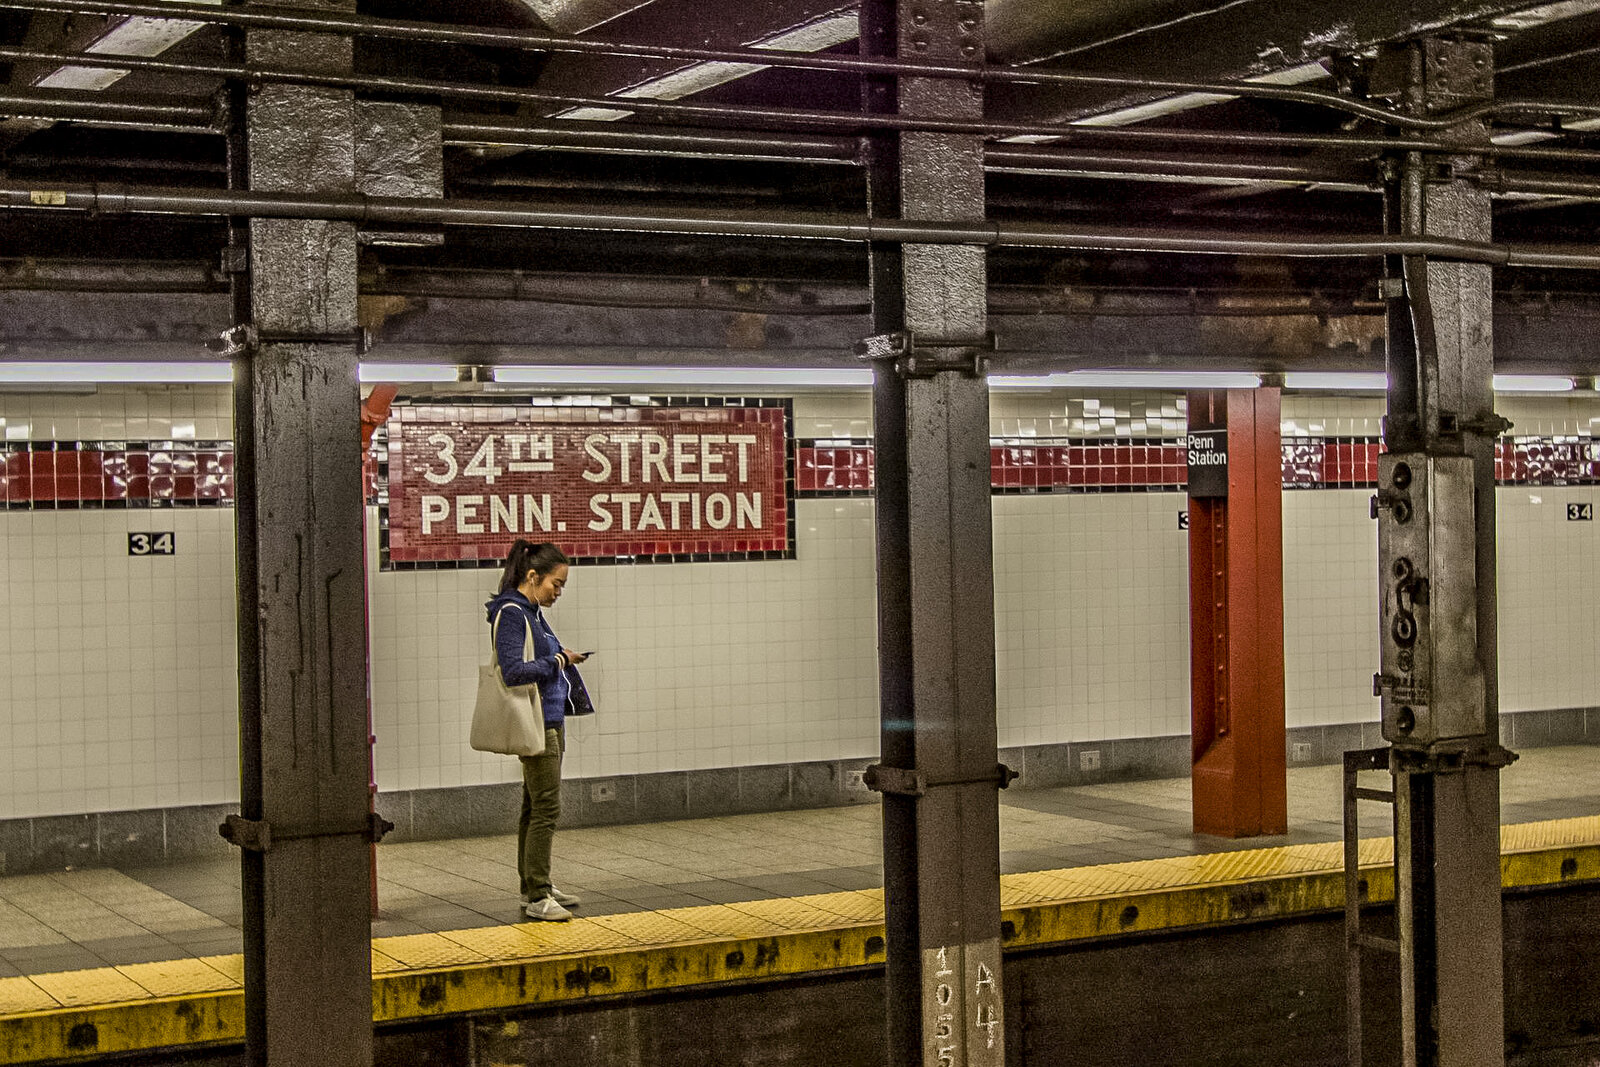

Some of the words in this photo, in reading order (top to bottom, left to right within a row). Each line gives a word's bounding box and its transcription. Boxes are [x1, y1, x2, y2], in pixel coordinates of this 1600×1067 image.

[1187, 434, 1214, 450] Penn
[424, 433, 554, 485] 34TH
[581, 433, 757, 484] STREET
[1188, 449, 1227, 466] Station
[421, 494, 567, 535] PENN.
[587, 491, 763, 532] STATION
[1569, 504, 1592, 520] 34
[131, 533, 173, 555] 34
